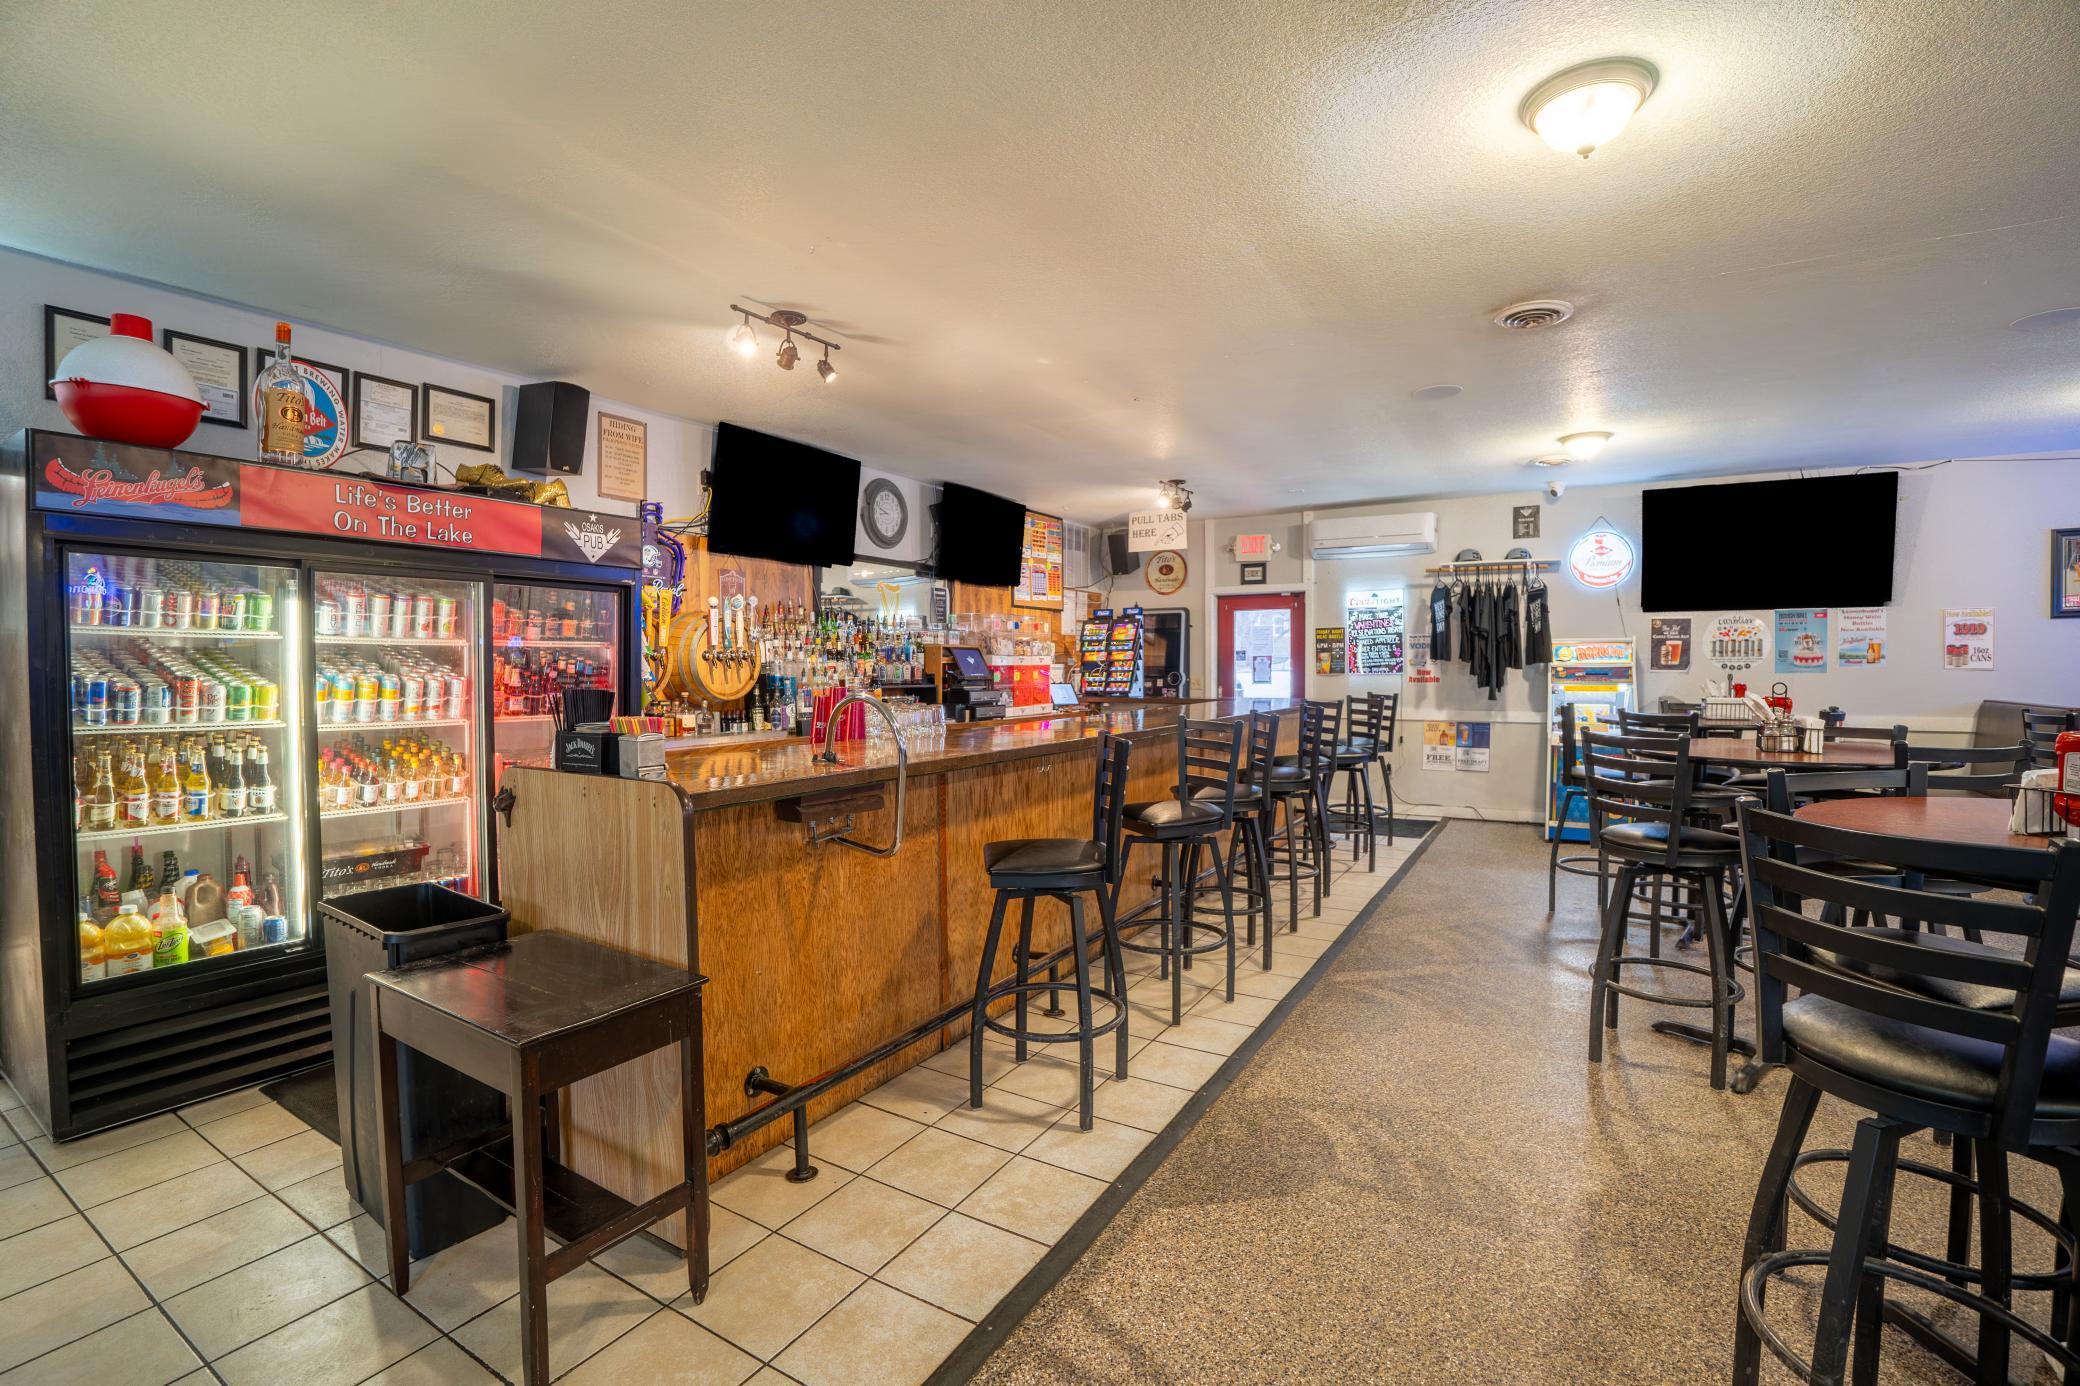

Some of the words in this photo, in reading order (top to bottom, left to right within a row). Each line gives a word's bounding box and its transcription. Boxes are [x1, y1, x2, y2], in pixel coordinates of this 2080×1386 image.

[303, 366, 340, 406] BREWING
[309, 411, 327, 428] Belt
[338, 410, 346, 444] WATER
[608, 419, 637, 433] HIDING
[603, 428, 624, 441] FROM
[625, 433, 642, 445] WIFE
[316, 446, 340, 466] MAKES
[72, 466, 206, 507] Leinenkugel's
[335, 484, 396, 511] Life's
[407, 494, 472, 520] Better
[334, 511, 367, 533] On
[378, 515, 417, 538] The
[427, 521, 473, 544] Lake
[581, 521, 604, 534] OSAKIS
[1132, 515, 1154, 526] PULL
[1157, 512, 1184, 523] TABS
[1132, 528, 1157, 538] HERE
[583, 535, 604, 550] PUB
[1241, 535, 1265, 554] EXIT
[1376, 597, 1400, 606] LIGHT
[1970, 654, 1993, 662] CANS
[322, 865, 354, 879] Tito's
